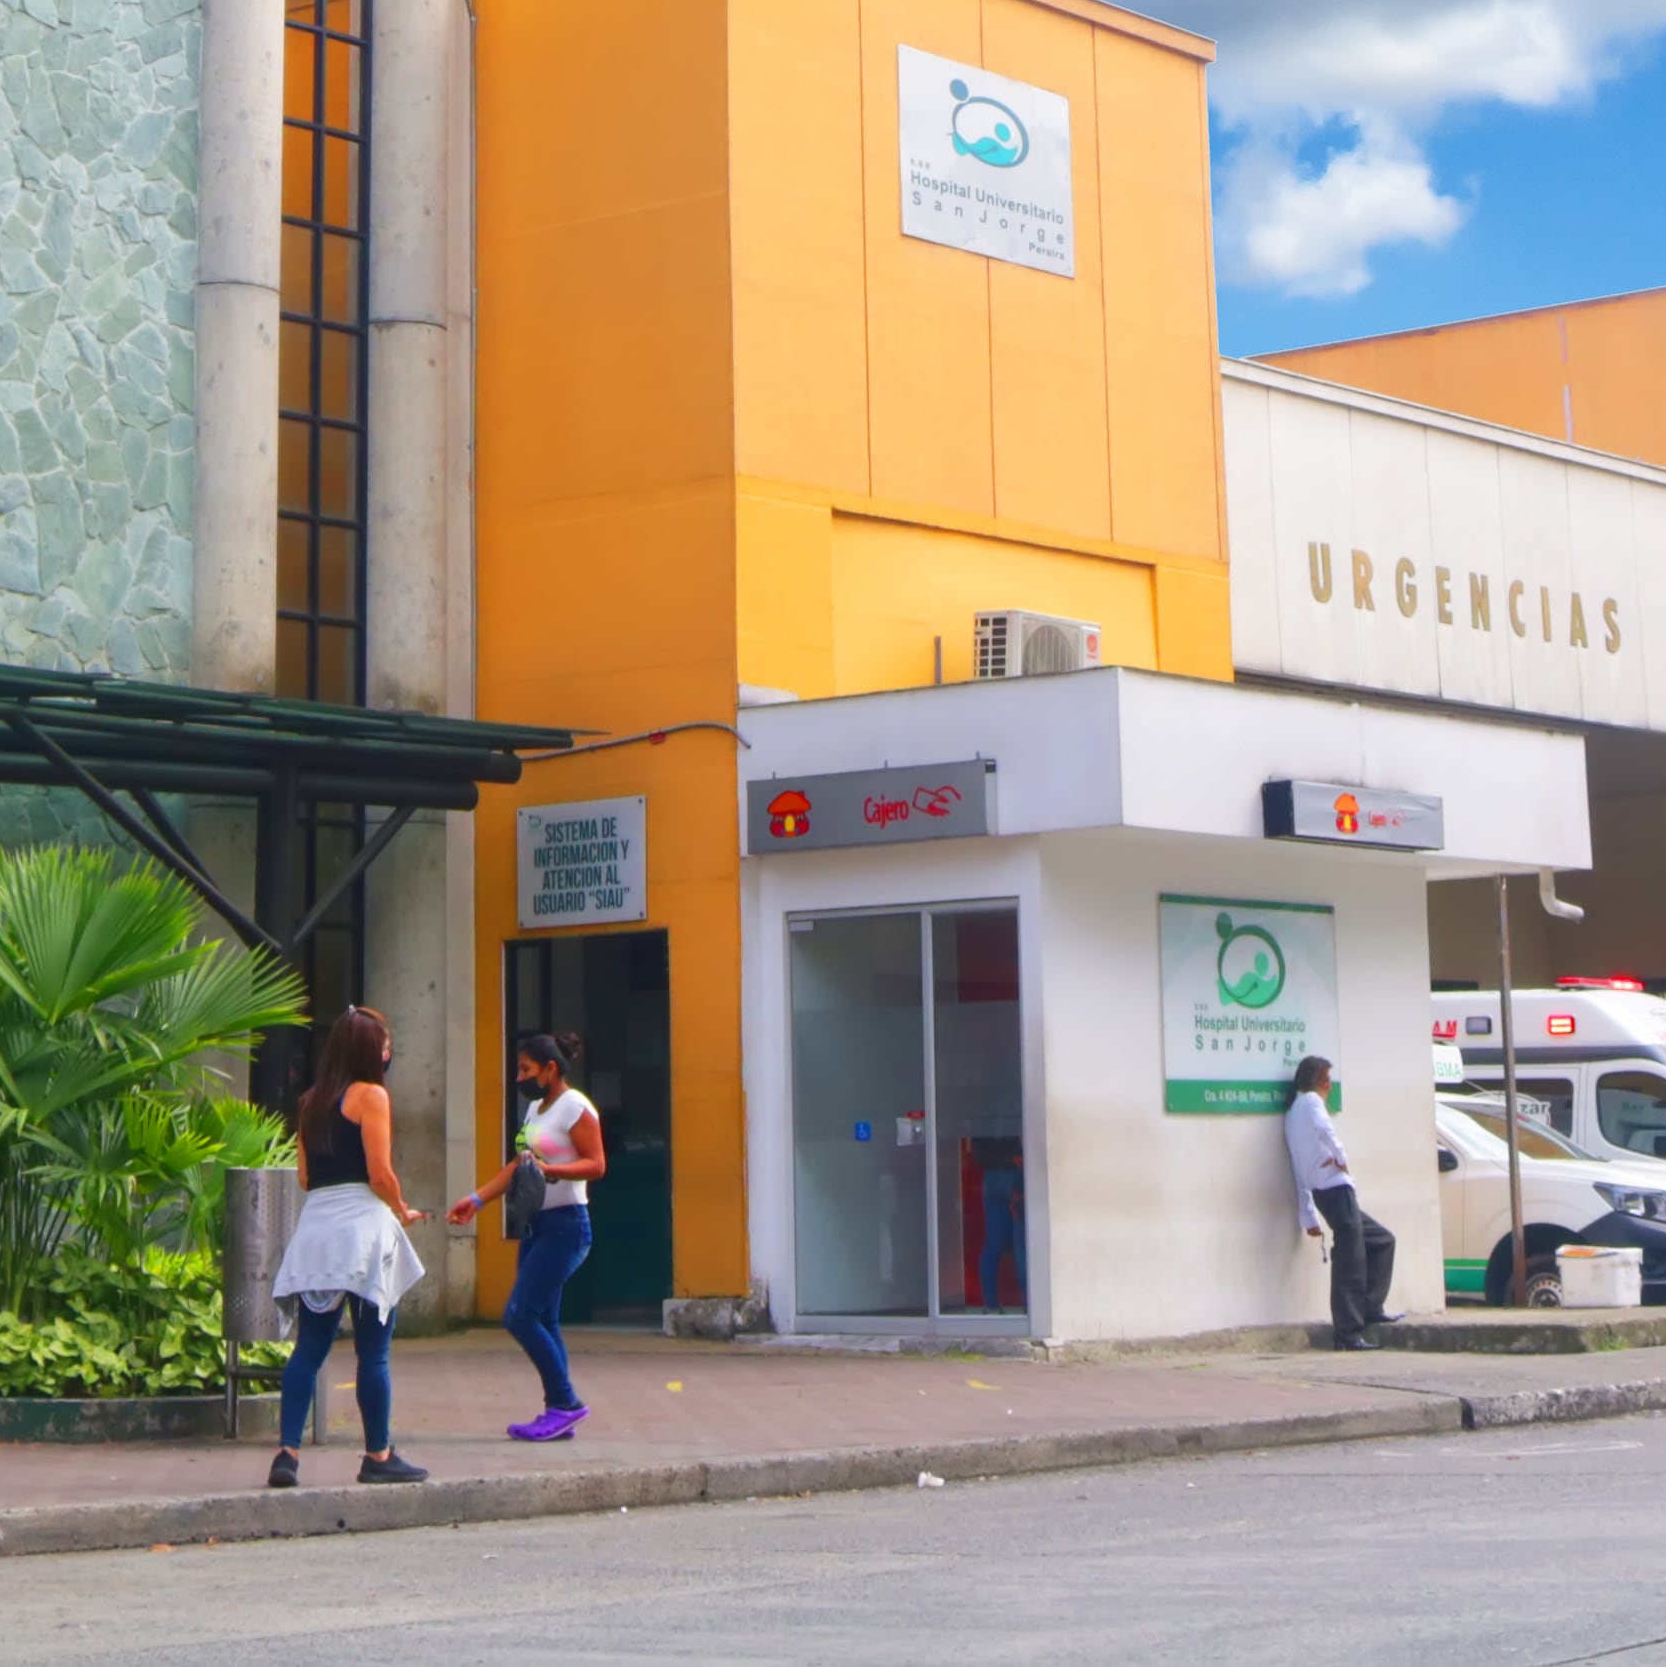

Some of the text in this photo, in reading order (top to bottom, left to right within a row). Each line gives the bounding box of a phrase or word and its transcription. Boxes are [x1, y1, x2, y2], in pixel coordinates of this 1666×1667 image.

[910, 170, 1064, 225] Hospital Universitario
[912, 191, 1065, 245] San Jorge
[1028, 242, 1065, 261] Pereira
[1307, 541, 1621, 654] URGENCIAS
[863, 795, 910, 830] Cajero
[544, 816, 618, 845] SISTEMA DE
[533, 839, 630, 869] INFORMACION Y
[542, 864, 621, 892] ATENCION AL
[533, 890, 586, 916] USUARIO
[1194, 1014, 1306, 1033] Hospital Universitario
[1195, 1034, 1306, 1056] San Jorge
